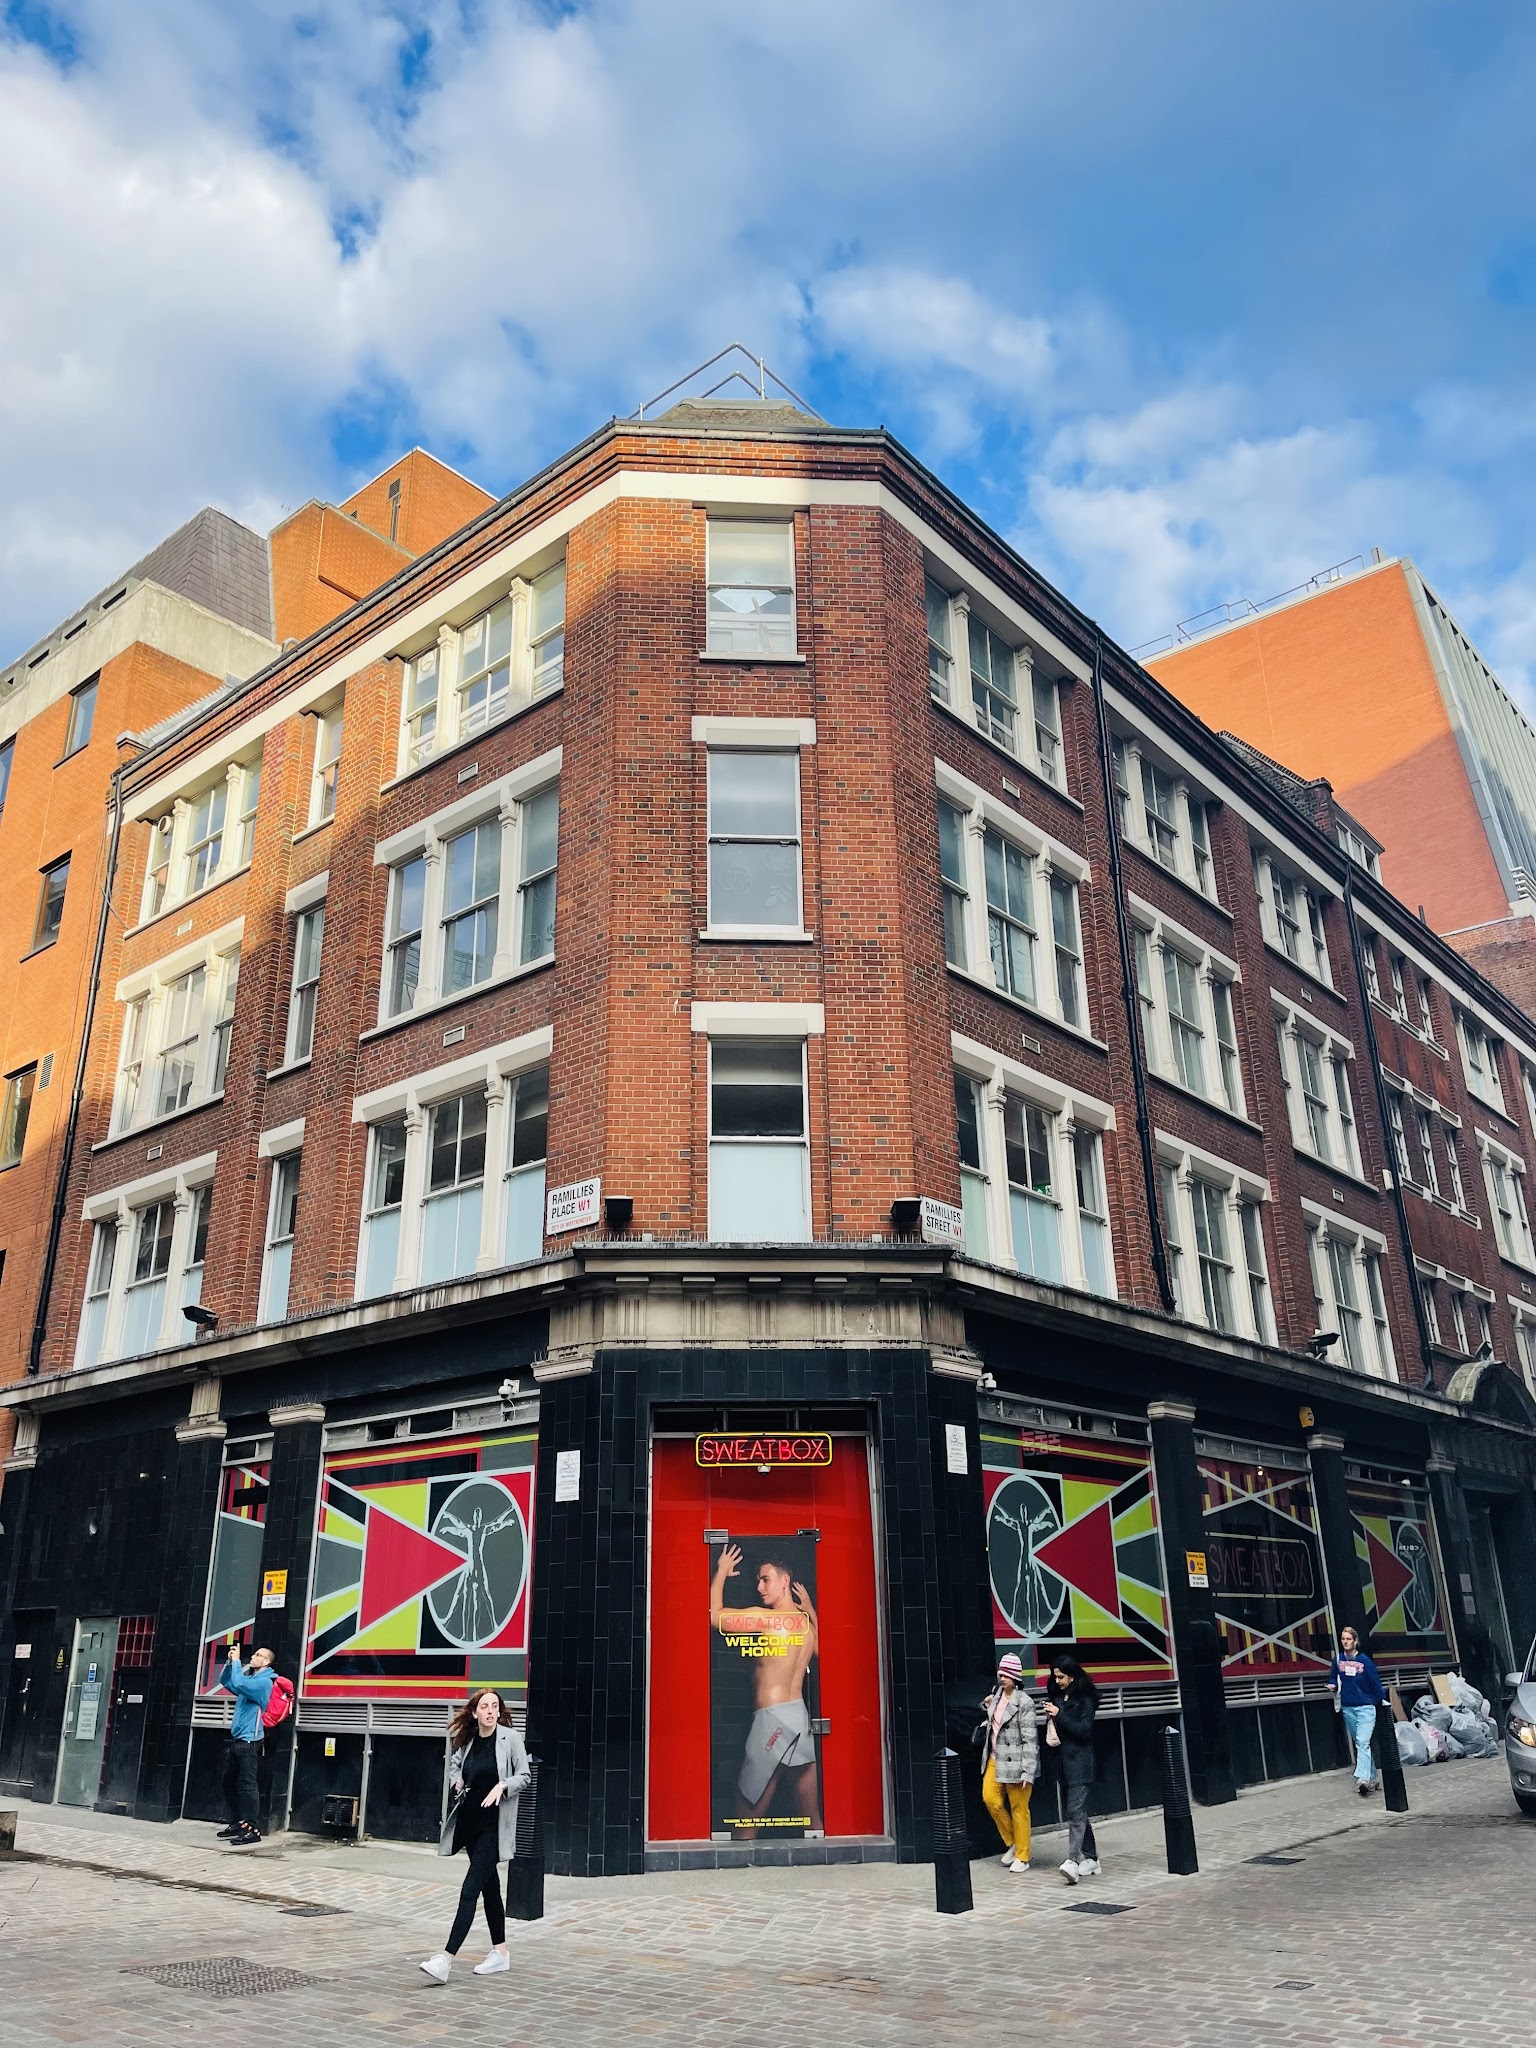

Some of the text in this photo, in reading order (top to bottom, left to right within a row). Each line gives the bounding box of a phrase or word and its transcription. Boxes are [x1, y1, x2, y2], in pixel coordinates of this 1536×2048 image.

[552, 1184, 594, 1205] RAMILLIES
[551, 1199, 590, 1219] PLACE W1
[925, 1201, 962, 1224] RAMILLIES
[926, 1215, 962, 1238] STREET W1
[702, 1439, 826, 1462] SWEATBOX
[1208, 1543, 1310, 1588] SWEATBOX
[723, 1616, 805, 1632] SWEATBOX
[725, 1636, 805, 1647] WELCOME
[741, 1647, 788, 1658] HOME
